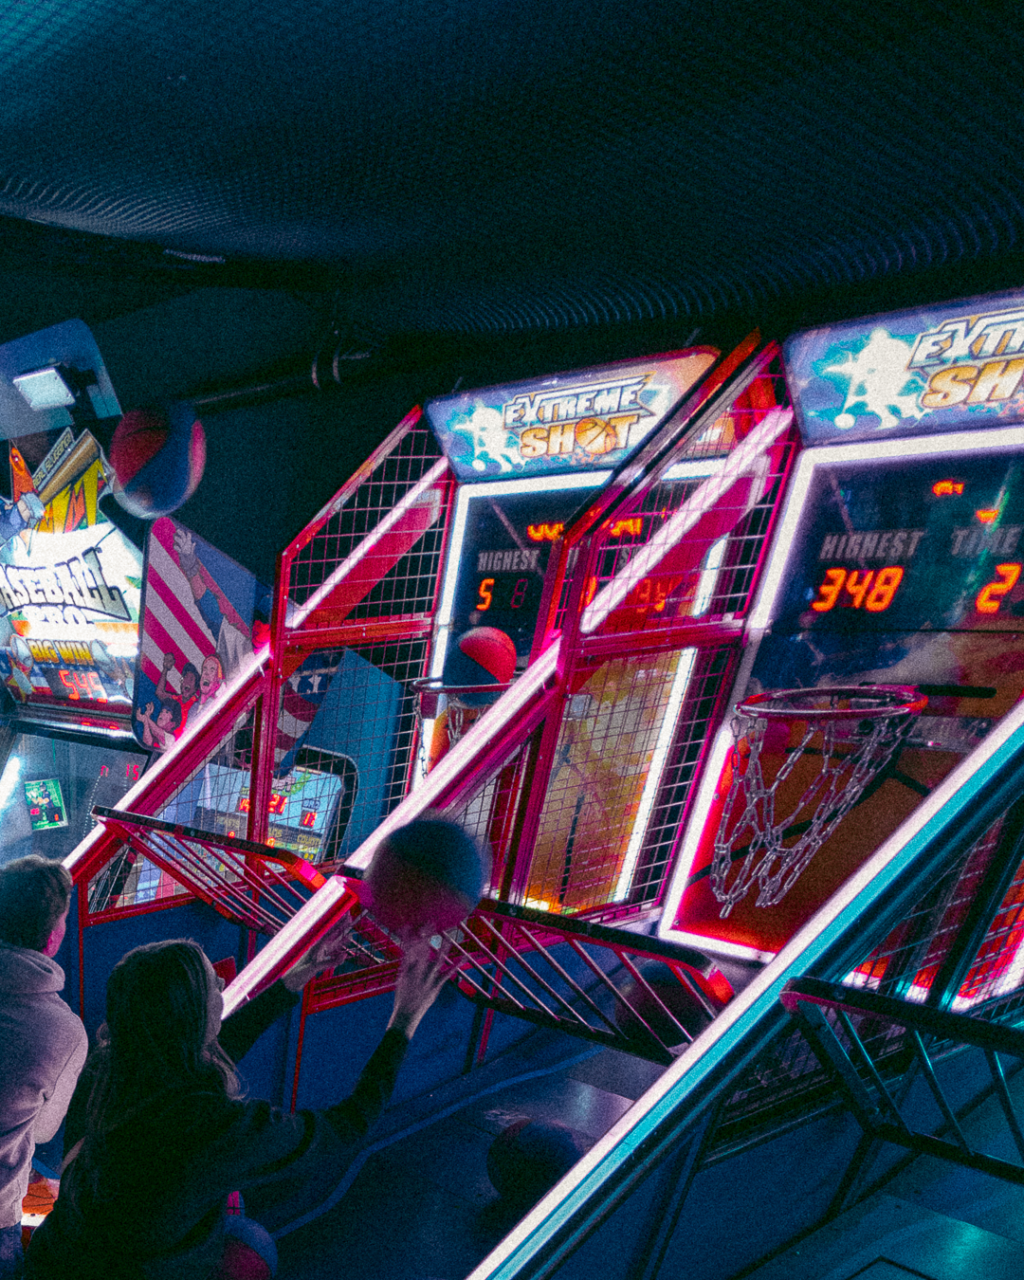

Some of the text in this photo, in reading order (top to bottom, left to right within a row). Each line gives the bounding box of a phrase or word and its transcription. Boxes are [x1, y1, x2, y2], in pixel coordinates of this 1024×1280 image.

[504, 373, 656, 428] EXTREME
[521, 415, 640, 457] SHOT
[819, 526, 1022, 560] HIGHEST TIME
[477, 549, 539, 573] HIGHEST
[812, 565, 904, 613] 348
[26, 640, 94, 665] BIG WIN
[59, 669, 107, 703] 545
